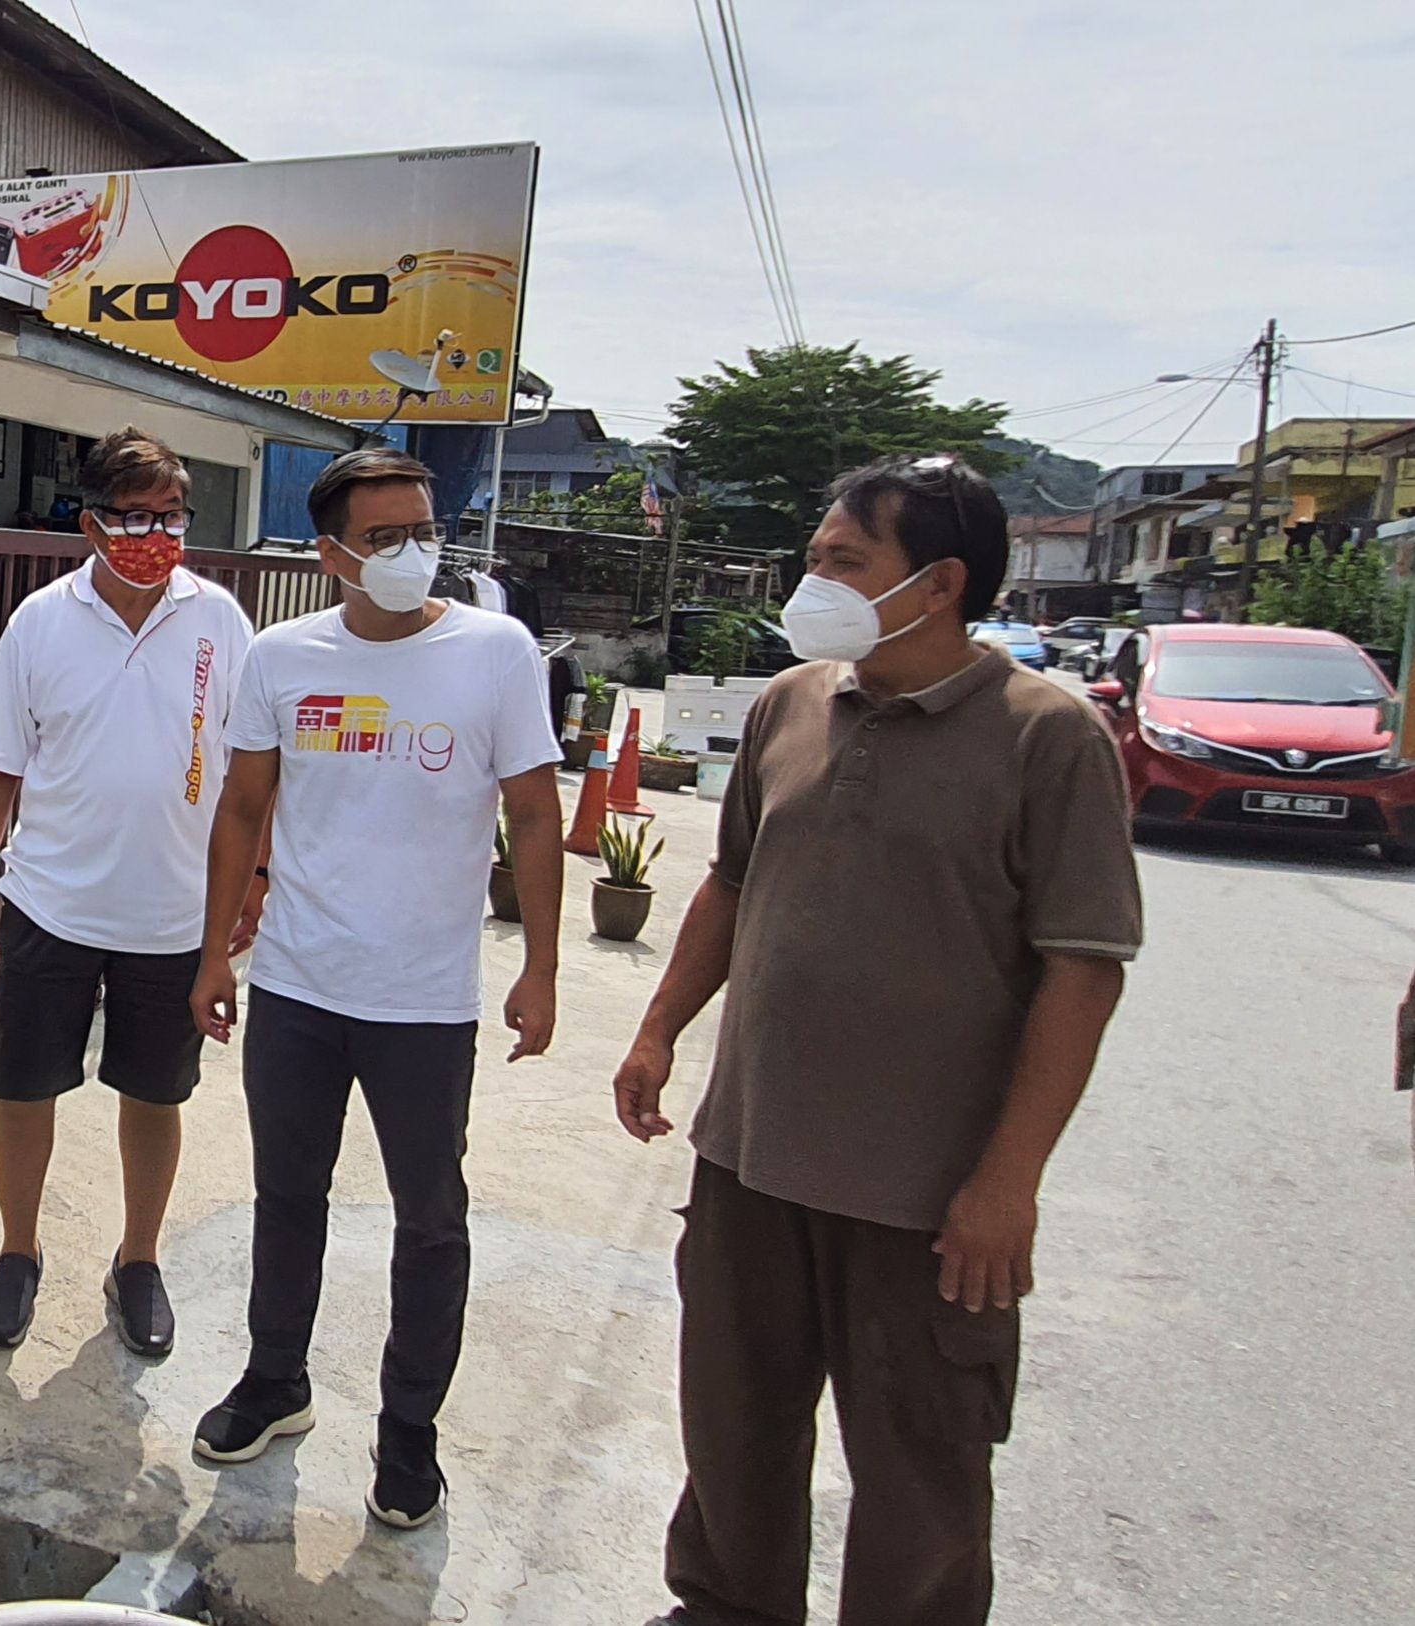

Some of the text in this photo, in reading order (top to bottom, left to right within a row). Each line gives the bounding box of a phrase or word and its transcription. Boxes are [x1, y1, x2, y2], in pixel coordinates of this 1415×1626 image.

[397, 145, 515, 162] www.koyoko.com.my
[6, 181, 33, 191] ALAT
[35, 178, 67, 189] GANTI
[88, 273, 390, 322] KOYOKO
